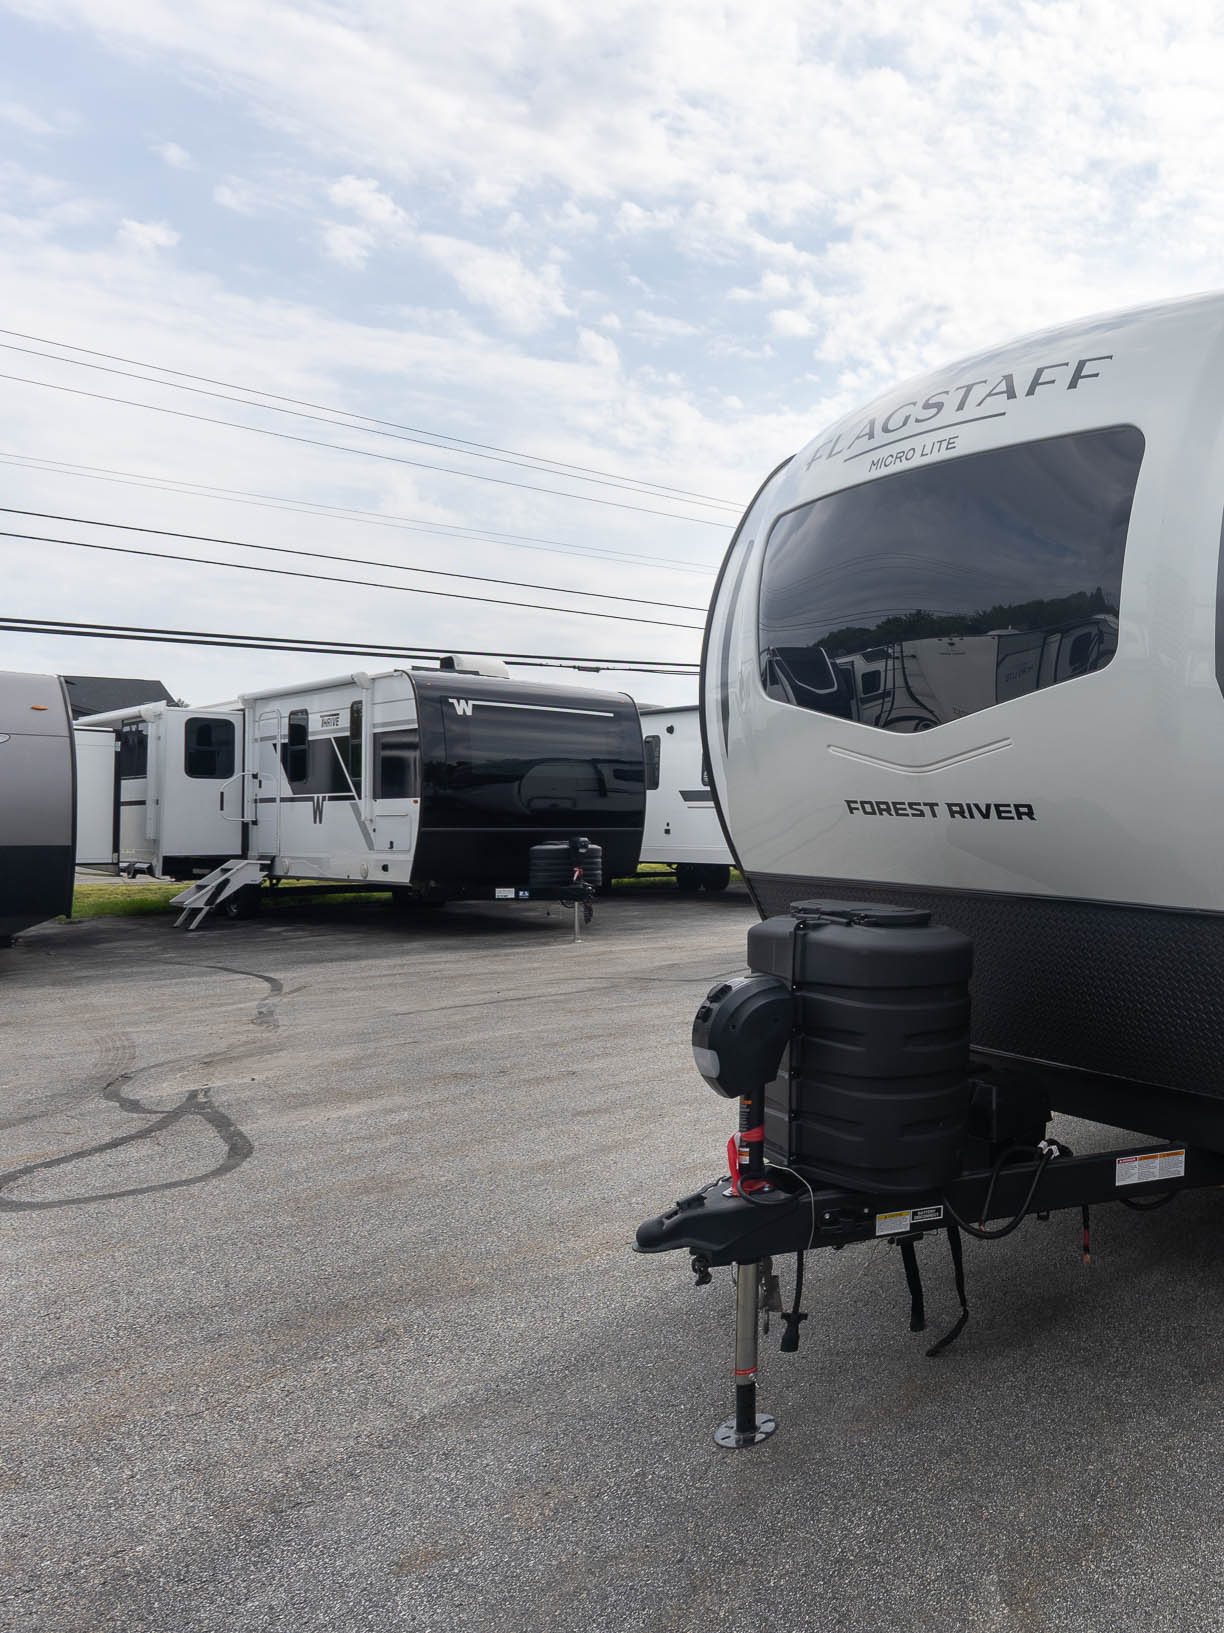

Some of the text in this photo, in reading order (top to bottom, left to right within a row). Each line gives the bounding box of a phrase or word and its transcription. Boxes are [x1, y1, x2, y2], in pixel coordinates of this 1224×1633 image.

[806, 355, 1113, 472] FLAGSTAFF
[869, 435, 960, 473] MICRO LITE
[844, 799, 1037, 822] FOREST RIVER
